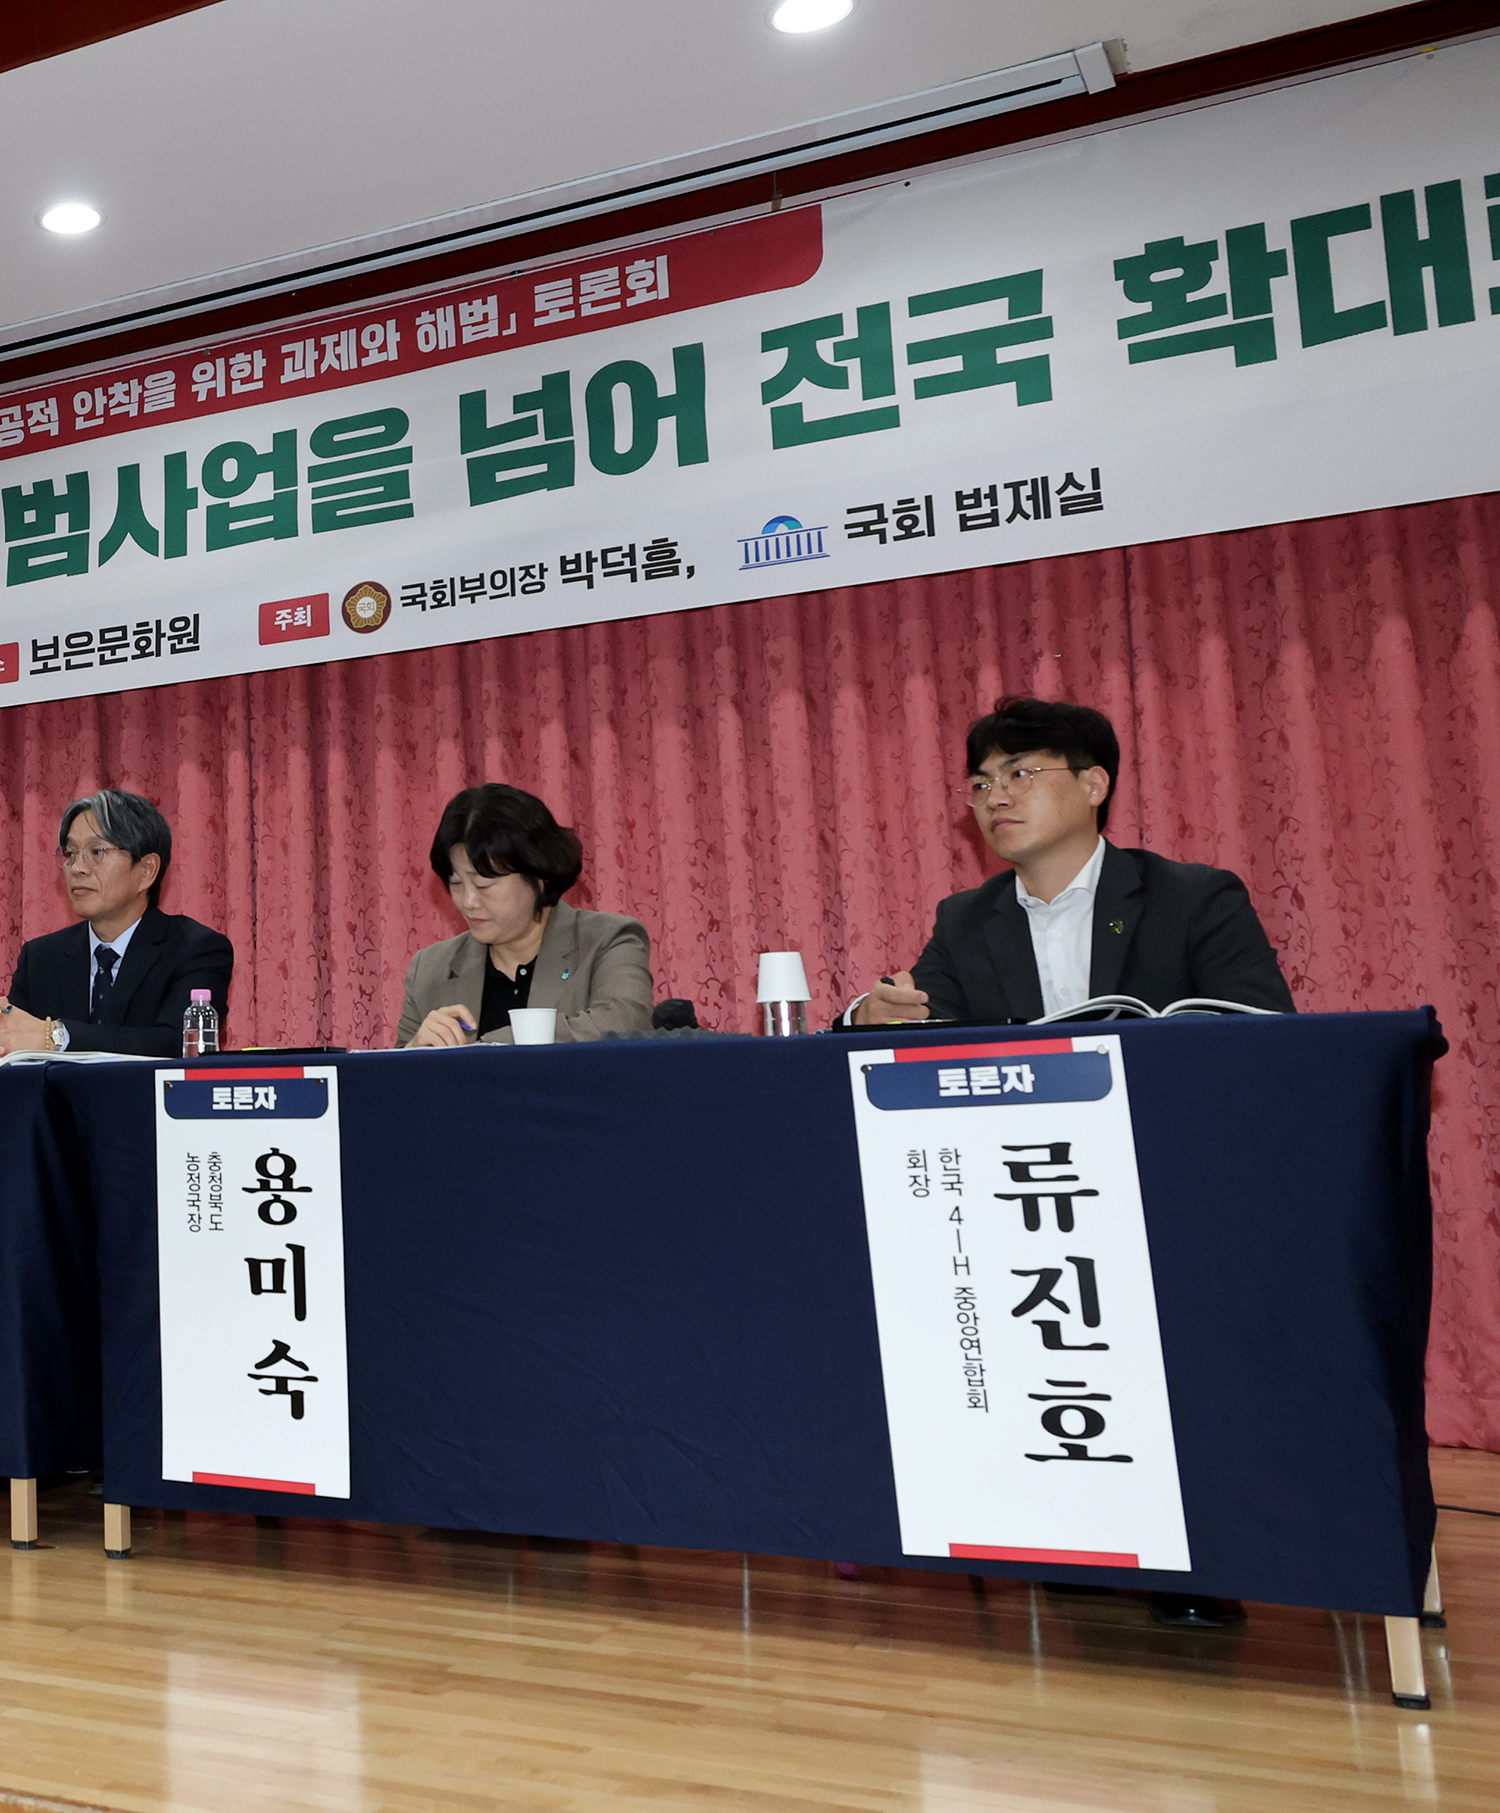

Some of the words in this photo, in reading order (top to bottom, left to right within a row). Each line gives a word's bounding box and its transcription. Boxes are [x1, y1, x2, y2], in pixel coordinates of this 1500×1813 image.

[73, 371, 176, 430] 안착을
[192, 350, 266, 402] 위한
[281, 319, 400, 383] 과제와
[534, 255, 669, 325] 토론회
[459, 342, 709, 507] 넘어
[761, 269, 1054, 450] 전국
[1113, 173, 1500, 367] 확대
[845, 495, 935, 544] 국회
[955, 468, 1103, 532] 법제실
[275, 605, 311, 630] 주최
[400, 563, 548, 611] 국회부의장
[560, 538, 694, 589] 박덕흠,
[30, 614, 199, 675] 보은문화원
[213, 1086, 277, 1110] 토론자
[938, 1064, 1035, 1096] 토론자
[186, 1153, 202, 1232] 농정국장
[208, 1152, 223, 1230] 충청북도
[908, 1150, 930, 1197] 회장
[242, 1148, 318, 1419] 용미숙
[939, 1149, 963, 1196] 한국
[955, 1287, 988, 1412] 중앙연합회
[995, 1142, 1133, 1463] 류진호
